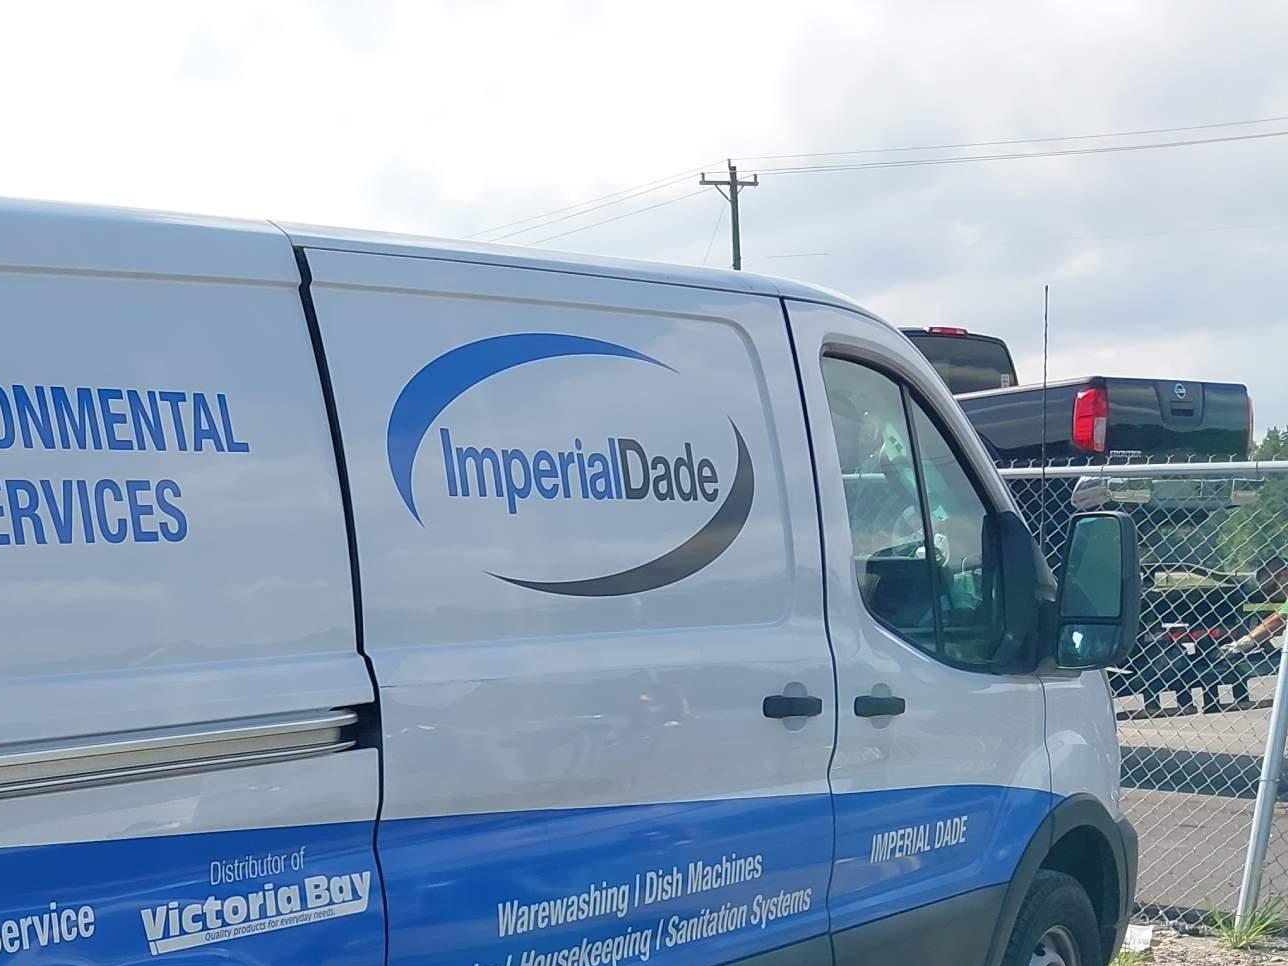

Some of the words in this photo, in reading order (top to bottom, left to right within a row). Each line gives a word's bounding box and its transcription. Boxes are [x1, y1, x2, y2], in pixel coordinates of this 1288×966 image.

[439, 427, 720, 515] ImperialDade
[210, 852, 286, 886] Distributor
[290, 846, 306, 871] of
[870, 824, 931, 864] IMPERIAL
[934, 815, 968, 850] DADE
[141, 881, 301, 940] Victoria
[304, 871, 371, 911] Bay
[497, 881, 628, 938] Warewashing
[644, 870, 682, 906] Dish
[687, 853, 763, 902] Machines
[665, 902, 747, 949] Sanitation
[751, 888, 812, 928] Systems
[204, 928, 232, 942] Quality
[233, 922, 266, 936] products
[267, 919, 280, 929] for
[280, 912, 313, 927] everyday
